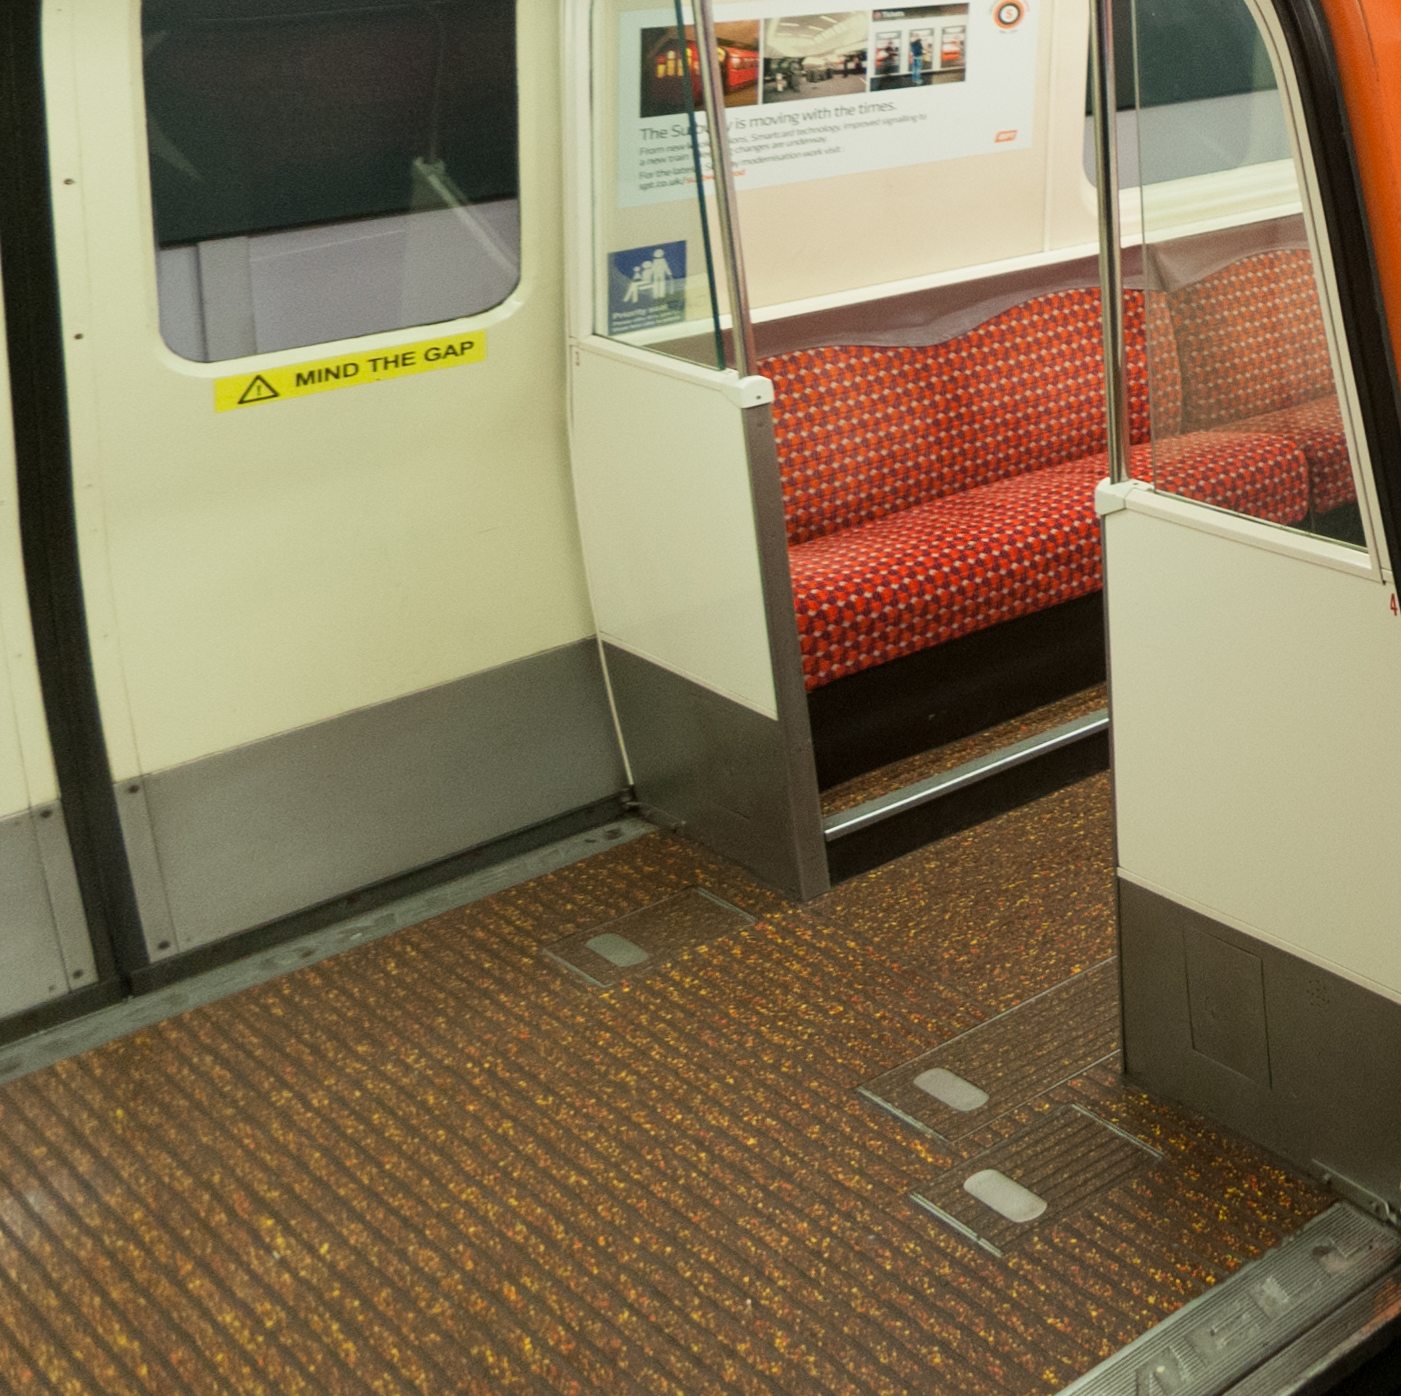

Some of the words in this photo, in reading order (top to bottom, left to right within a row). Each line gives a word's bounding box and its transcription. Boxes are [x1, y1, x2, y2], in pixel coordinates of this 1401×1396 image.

[640, 127, 668, 141] The
[735, 116, 746, 128] is
[749, 112, 799, 128] moving
[802, 107, 832, 121] with
[834, 105, 856, 117] the
[858, 102, 898, 115] times.
[295, 362, 359, 388] MIND
[368, 351, 417, 373] THE
[423, 340, 475, 363] GAP
